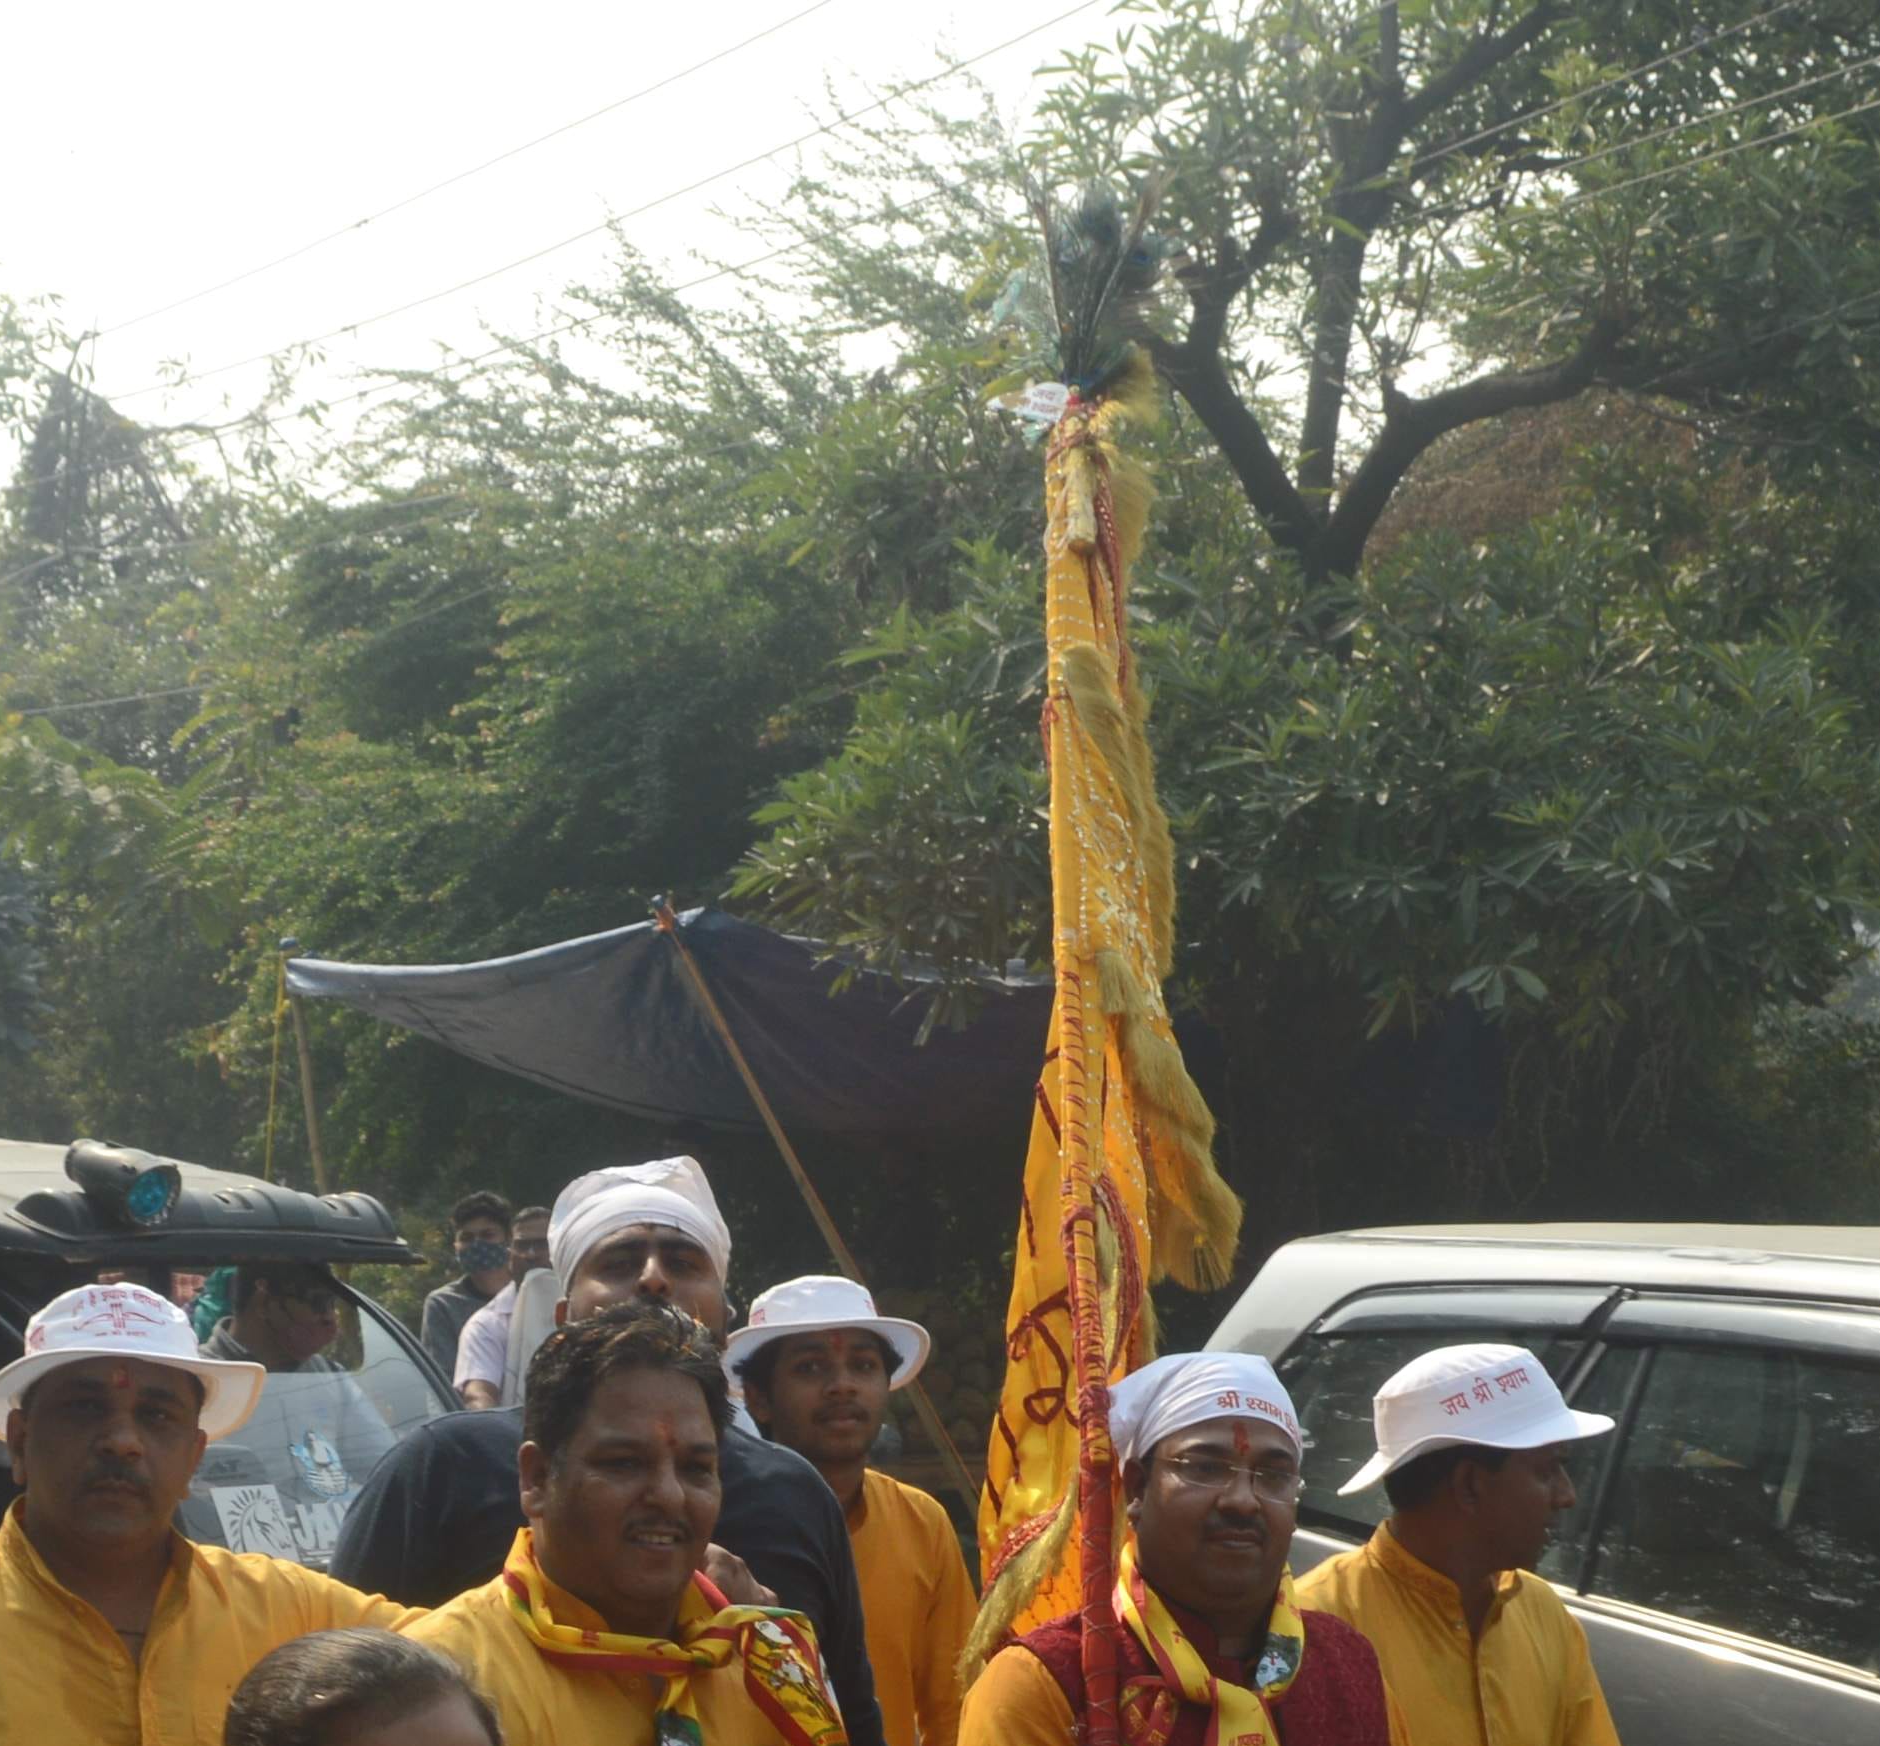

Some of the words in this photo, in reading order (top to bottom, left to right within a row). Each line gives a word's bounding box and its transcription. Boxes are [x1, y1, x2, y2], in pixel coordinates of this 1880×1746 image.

[1216, 1390, 1240, 1409] श्री
[1438, 1391, 1471, 1416] जय
[1472, 1376, 1495, 1405] श्री
[1494, 1367, 1531, 1397] श्याम
